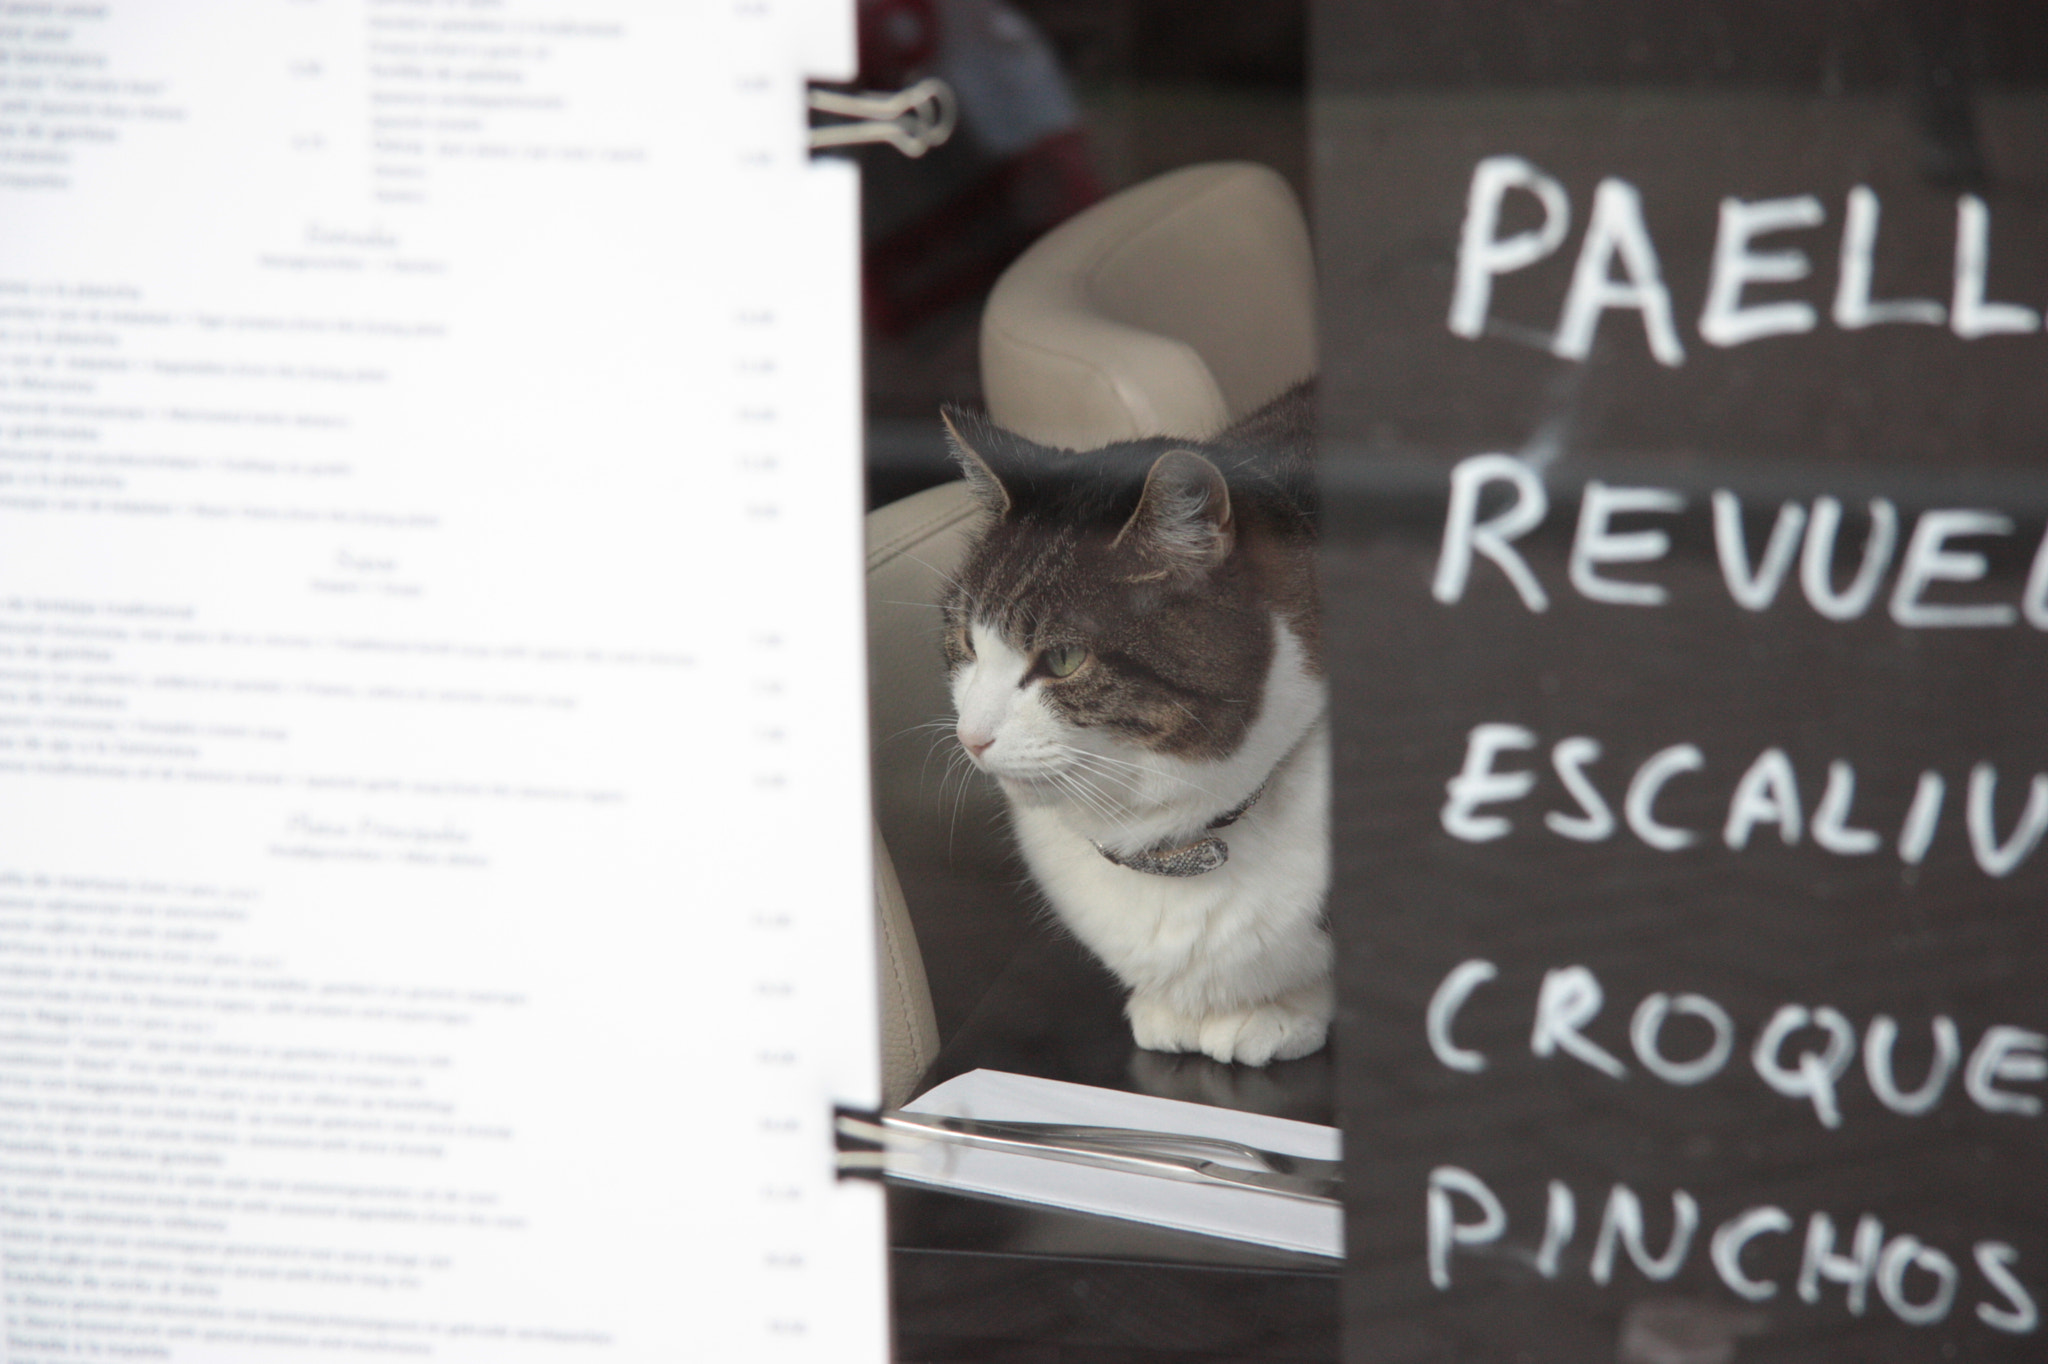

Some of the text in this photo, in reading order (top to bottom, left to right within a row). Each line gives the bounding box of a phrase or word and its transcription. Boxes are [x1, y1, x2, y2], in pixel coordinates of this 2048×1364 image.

[1449, 156, 2048, 366] PAELL
[1442, 723, 2048, 875] ESCALIV
[1426, 958, 2048, 1128] CROQUE
[1426, 1166, 2037, 1333] PINCHOS
